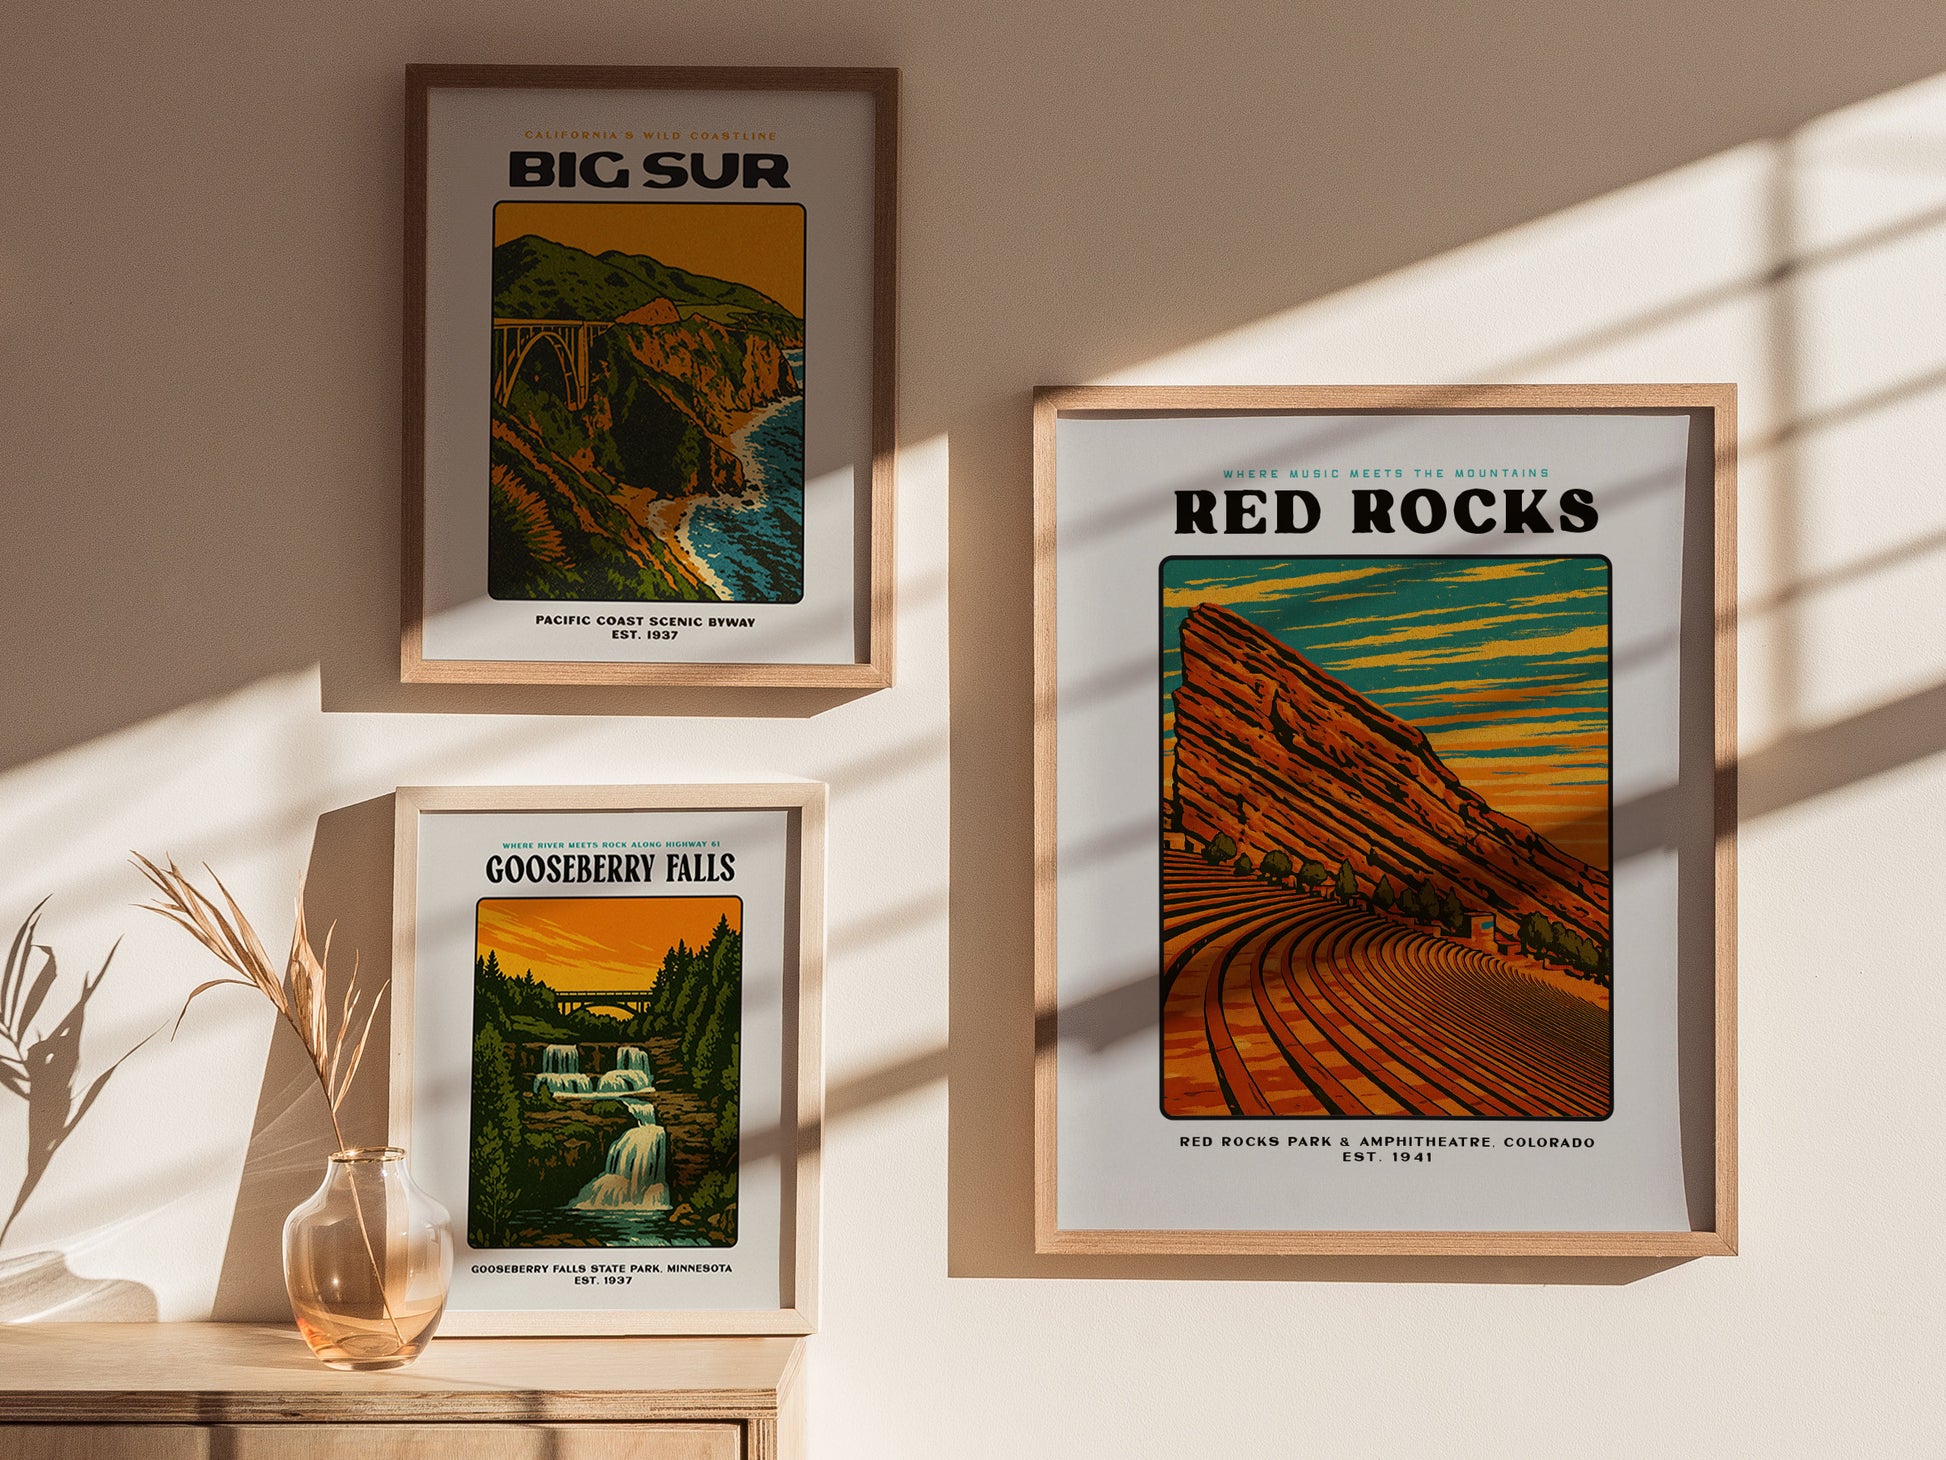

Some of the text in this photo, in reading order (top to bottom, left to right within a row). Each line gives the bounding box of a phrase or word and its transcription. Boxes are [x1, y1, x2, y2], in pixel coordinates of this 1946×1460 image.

[643, 131, 681, 141] WILD
[689, 131, 777, 141] COASTLINE
[509, 151, 791, 189] BIG SUR
[1223, 469, 1549, 479] WHERE MUSIC MEETS THE MOUNTAINS
[1174, 488, 1599, 534] RED ROCKS
[535, 615, 756, 628] PACIFIC COAST SCENIC BYWAY
[611, 629, 679, 641] EST. 1937
[502, 840, 721, 849] WHERE RIVER MEETS ROCK ALONG HIGHWAY 61
[486, 853, 736, 883] GOOSEBERRY FALLS
[1179, 1136, 1213, 1147] RED
[1221, 1136, 1280, 1147] ROCKS
[1288, 1136, 1332, 1147] PARK
[1340, 1137, 1351, 1147] &
[1503, 1137, 1595, 1149] COLORADO
[1342, 1151, 1432, 1162] EST. 1941
[471, 1265, 549, 1274] GOOSEBERRY
[553, 1265, 586, 1274] FALLS
[590, 1265, 626, 1274] STATE
[667, 1264, 733, 1273] MINNESOTA
[574, 1276, 633, 1285] EST. 1937
